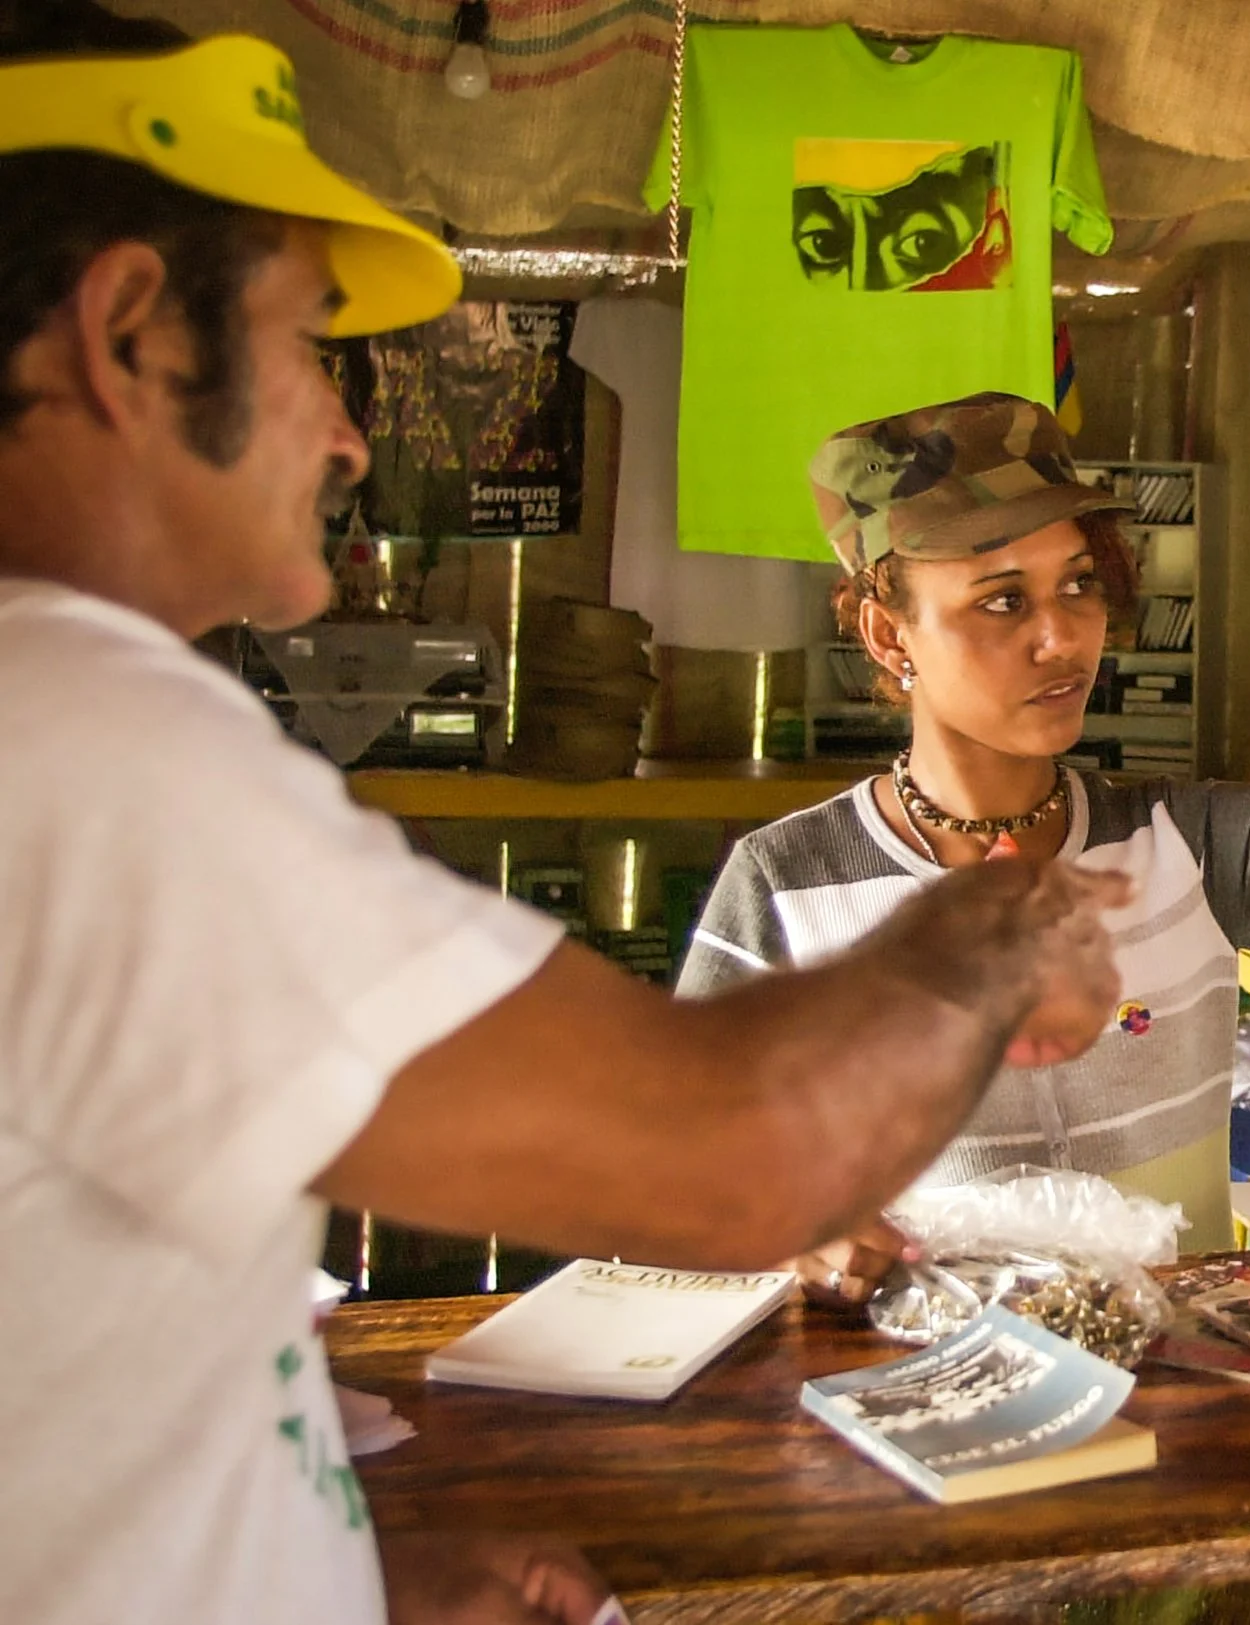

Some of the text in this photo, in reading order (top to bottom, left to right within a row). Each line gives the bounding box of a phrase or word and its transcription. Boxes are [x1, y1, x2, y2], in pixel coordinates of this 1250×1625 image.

[471, 482, 560, 502] Semana
[522, 501, 560, 519] PAZ
[581, 1266, 778, 1292] ACTIVIDAD
